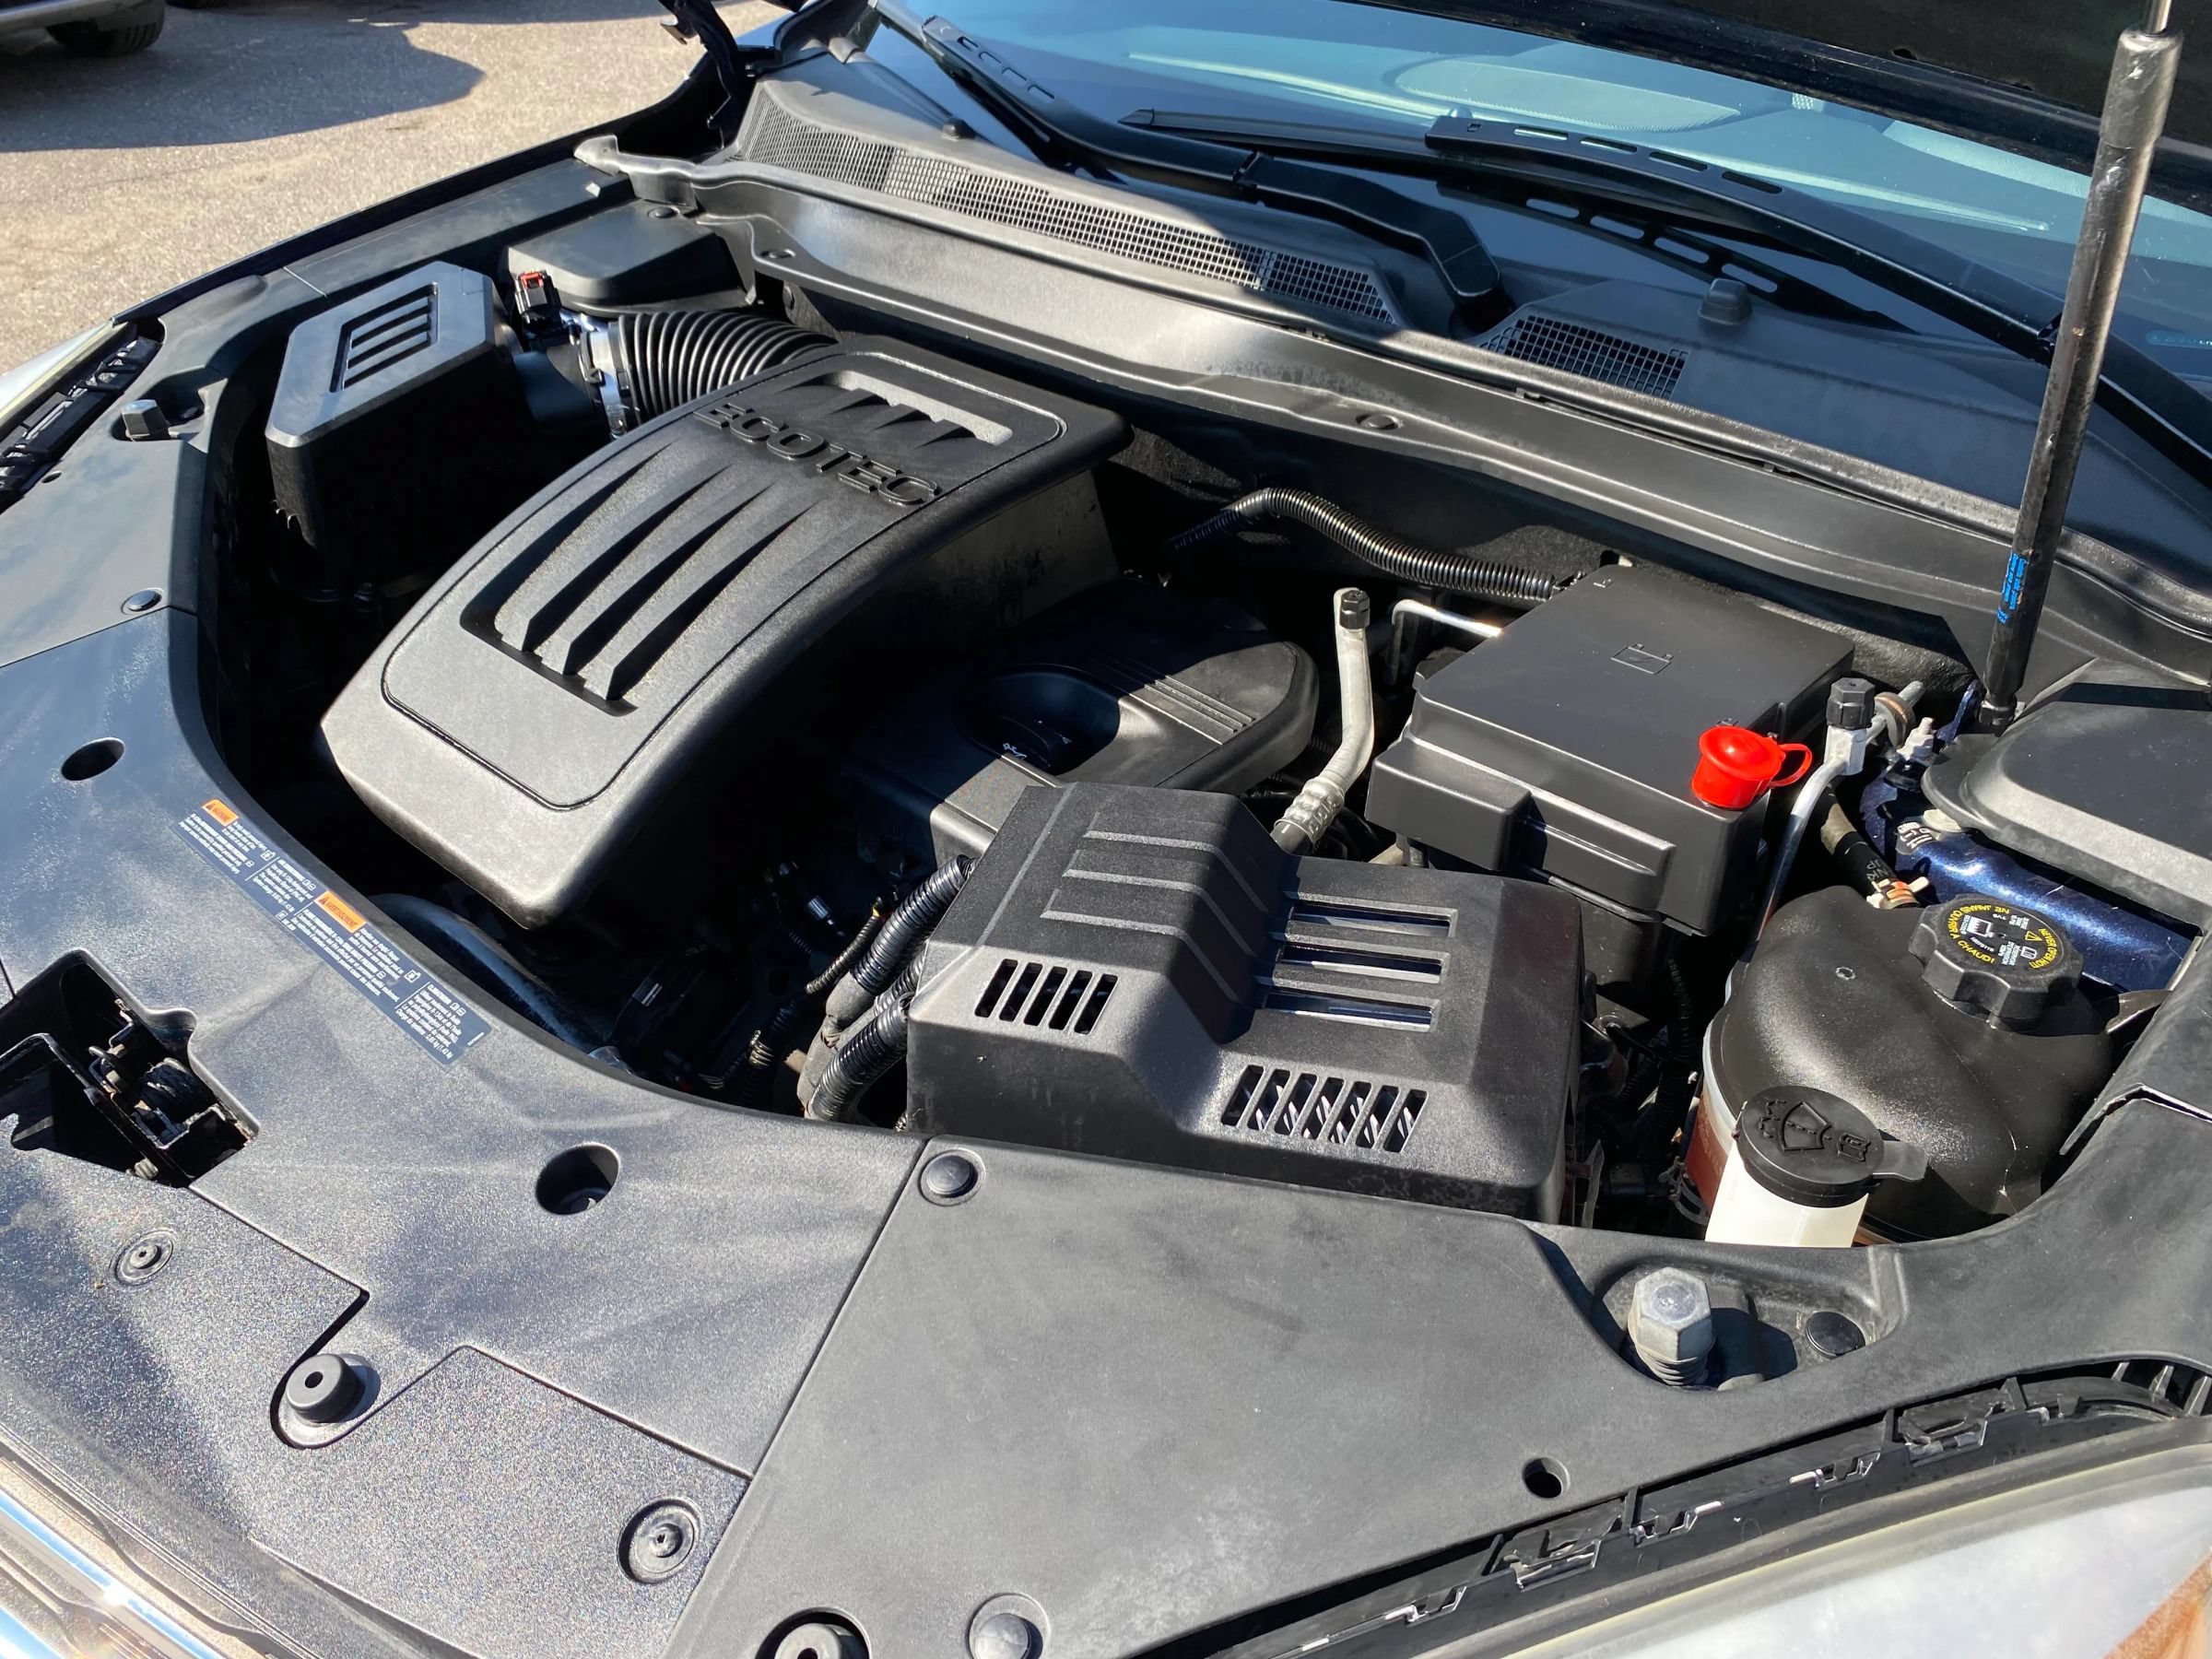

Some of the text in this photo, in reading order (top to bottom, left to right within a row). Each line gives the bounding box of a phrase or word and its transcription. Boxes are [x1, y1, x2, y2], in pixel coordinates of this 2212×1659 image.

[693, 403, 941, 506] ECOTEC
[2038, 927, 2056, 947] NEVER
[2043, 946, 2058, 961] OPEN
